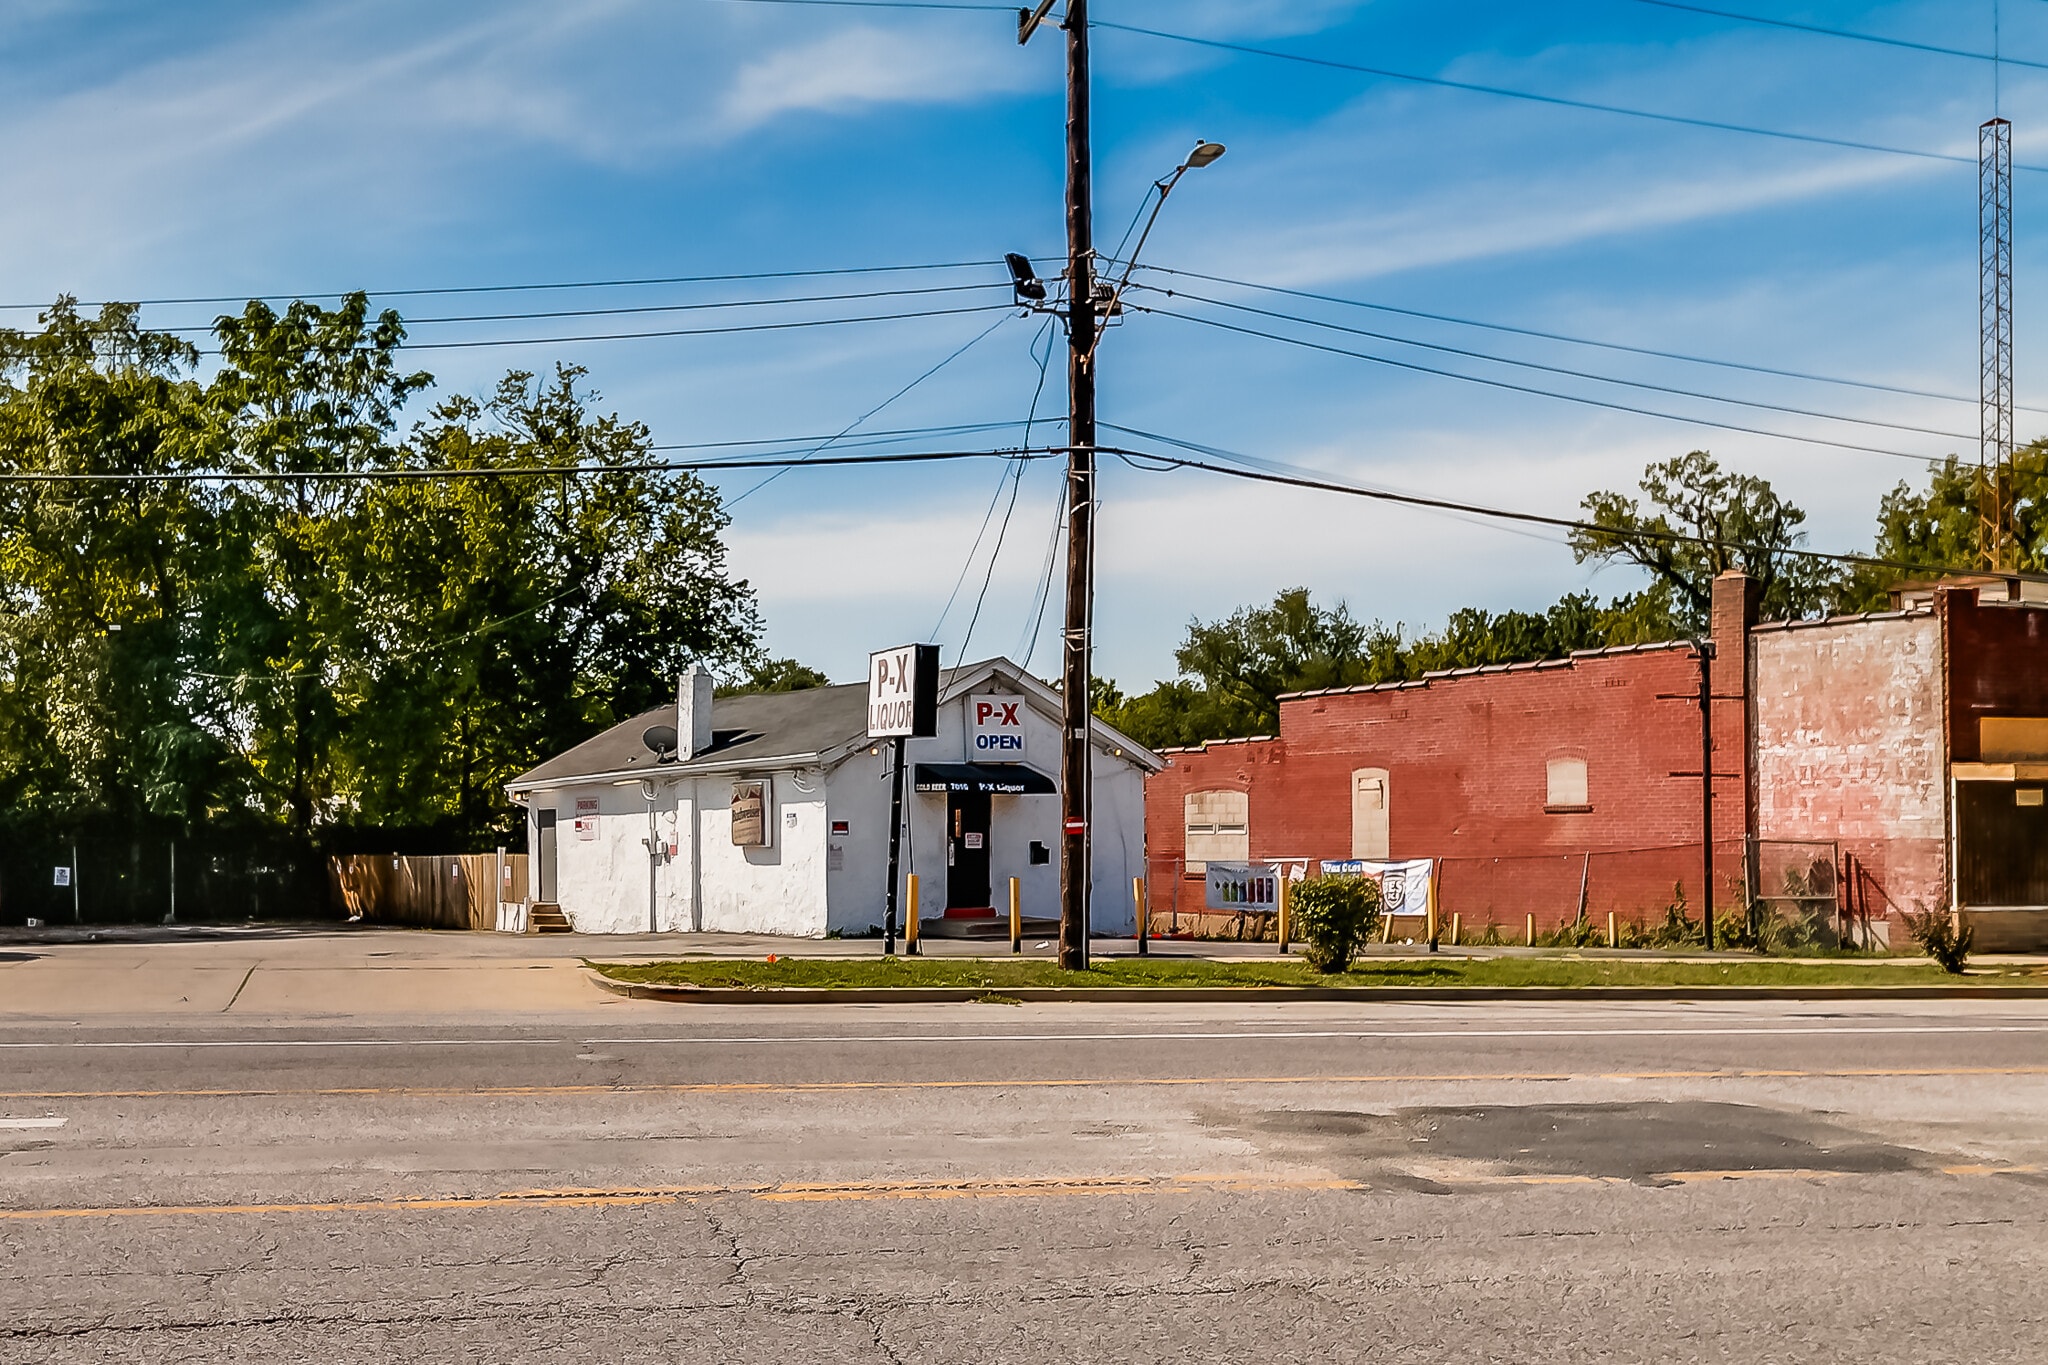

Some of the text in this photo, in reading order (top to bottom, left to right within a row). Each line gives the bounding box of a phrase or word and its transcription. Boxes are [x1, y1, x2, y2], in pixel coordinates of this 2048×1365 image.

[878, 653, 908, 697] P-X
[870, 700, 912, 730] LIQUOR
[976, 702, 1020, 726] P-X
[975, 734, 1022, 750] OPEN
[979, 783, 995, 791] P-X
[996, 784, 1025, 793] Liquor
